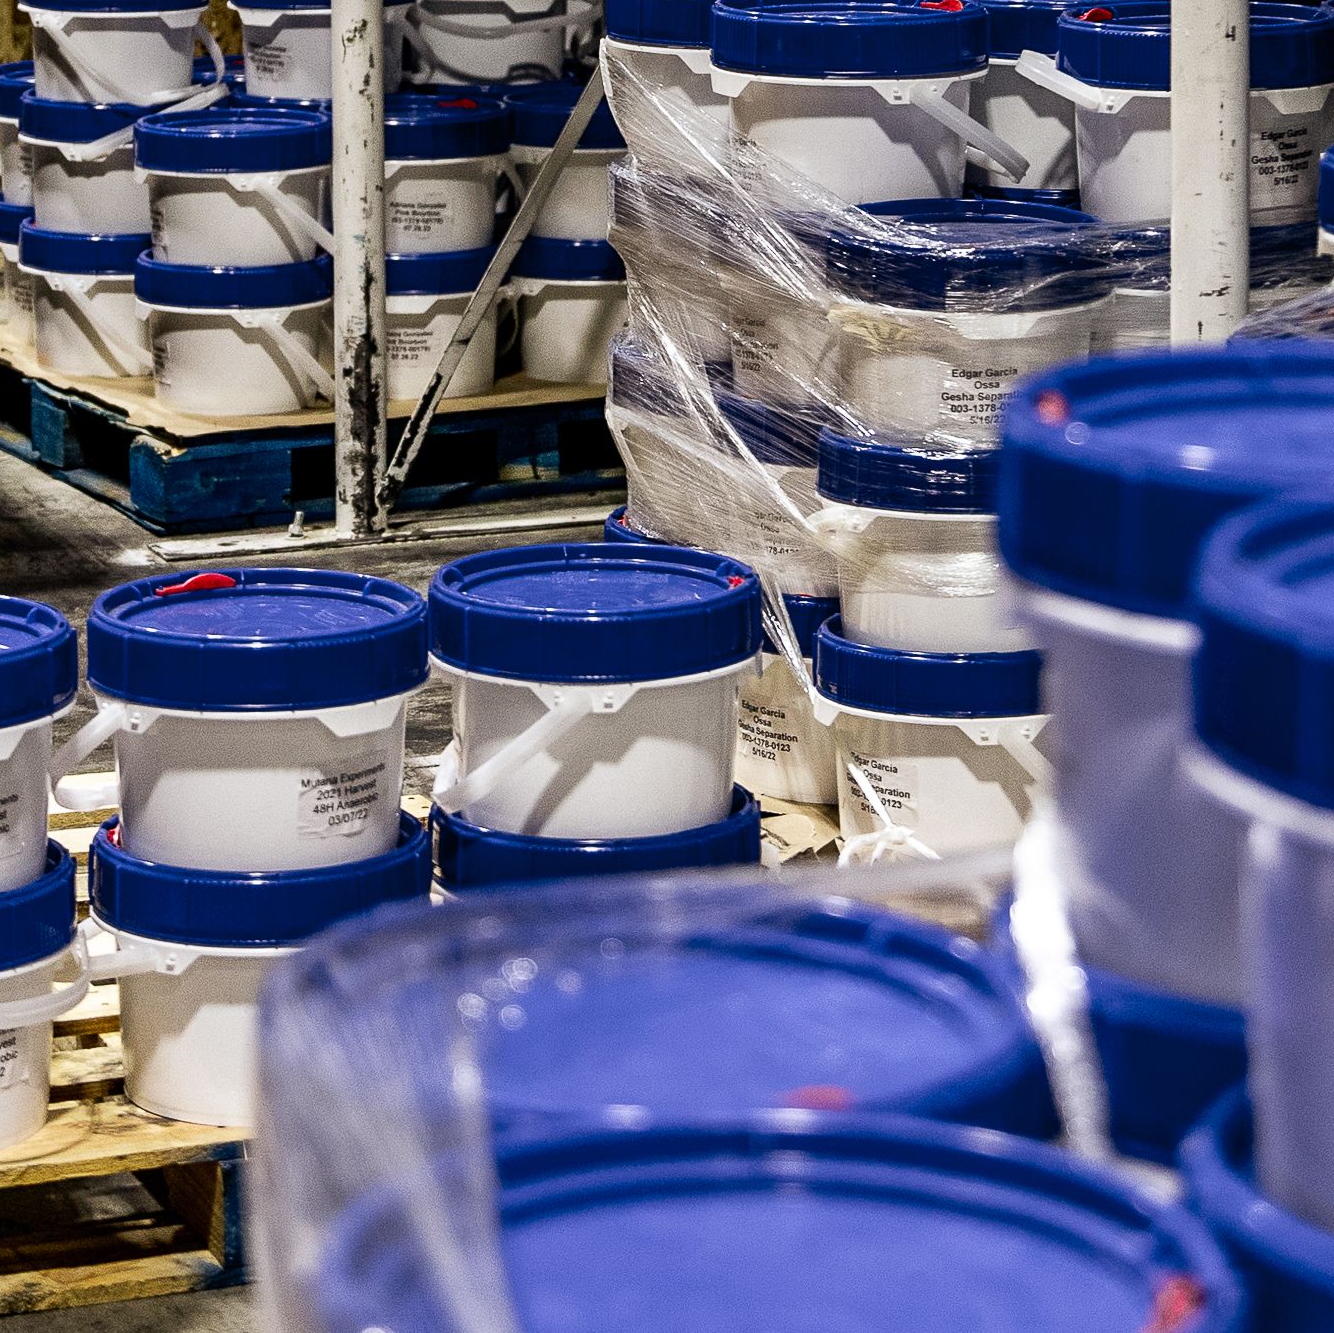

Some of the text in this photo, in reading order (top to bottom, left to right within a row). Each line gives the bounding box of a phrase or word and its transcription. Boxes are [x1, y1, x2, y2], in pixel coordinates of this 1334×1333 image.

[951, 368, 1018, 380] Edgar Garcia
[974, 381, 1000, 390] Ossa
[941, 392, 975, 401] Gesha
[760, 707, 786, 719] Garcia
[753, 715, 772, 727] Ossa
[756, 727, 799, 743] Separation
[752, 747, 776, 761] 5/16/22
[871, 760, 899, 773] Garcia
[301, 776, 338, 788] Mutana
[863, 769, 883, 782] Ossa
[317, 778, 377, 801] 2021 Harvest
[313, 792, 379, 814] 48H Anaerobic
[328, 808, 369, 826] 03/07/22
